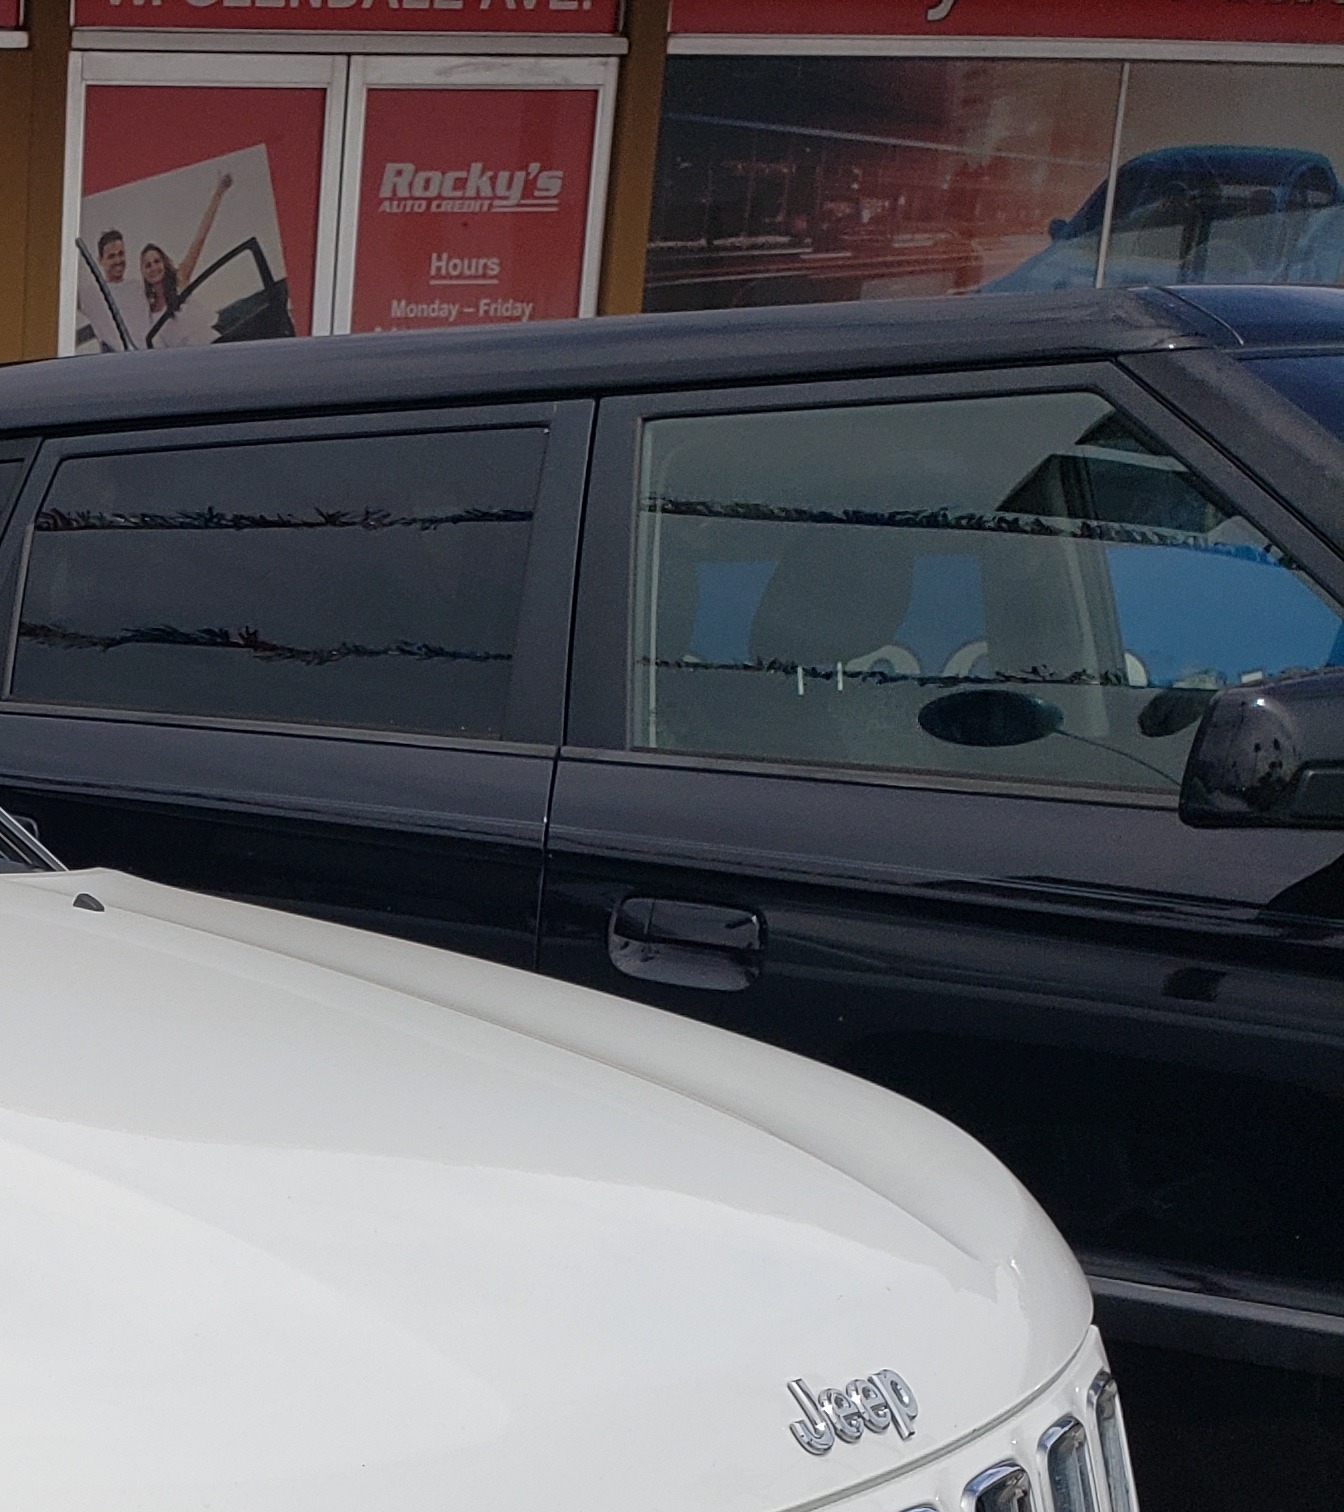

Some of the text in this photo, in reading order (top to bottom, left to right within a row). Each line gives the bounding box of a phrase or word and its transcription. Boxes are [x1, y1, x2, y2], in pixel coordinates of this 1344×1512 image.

[379, 161, 563, 206] Rocky's
[379, 200, 492, 212] AUTO CREDIT
[430, 252, 500, 276] Hours
[391, 299, 459, 322] Monday
[479, 299, 533, 322] Friday
[787, 1368, 918, 1456] Jeep
